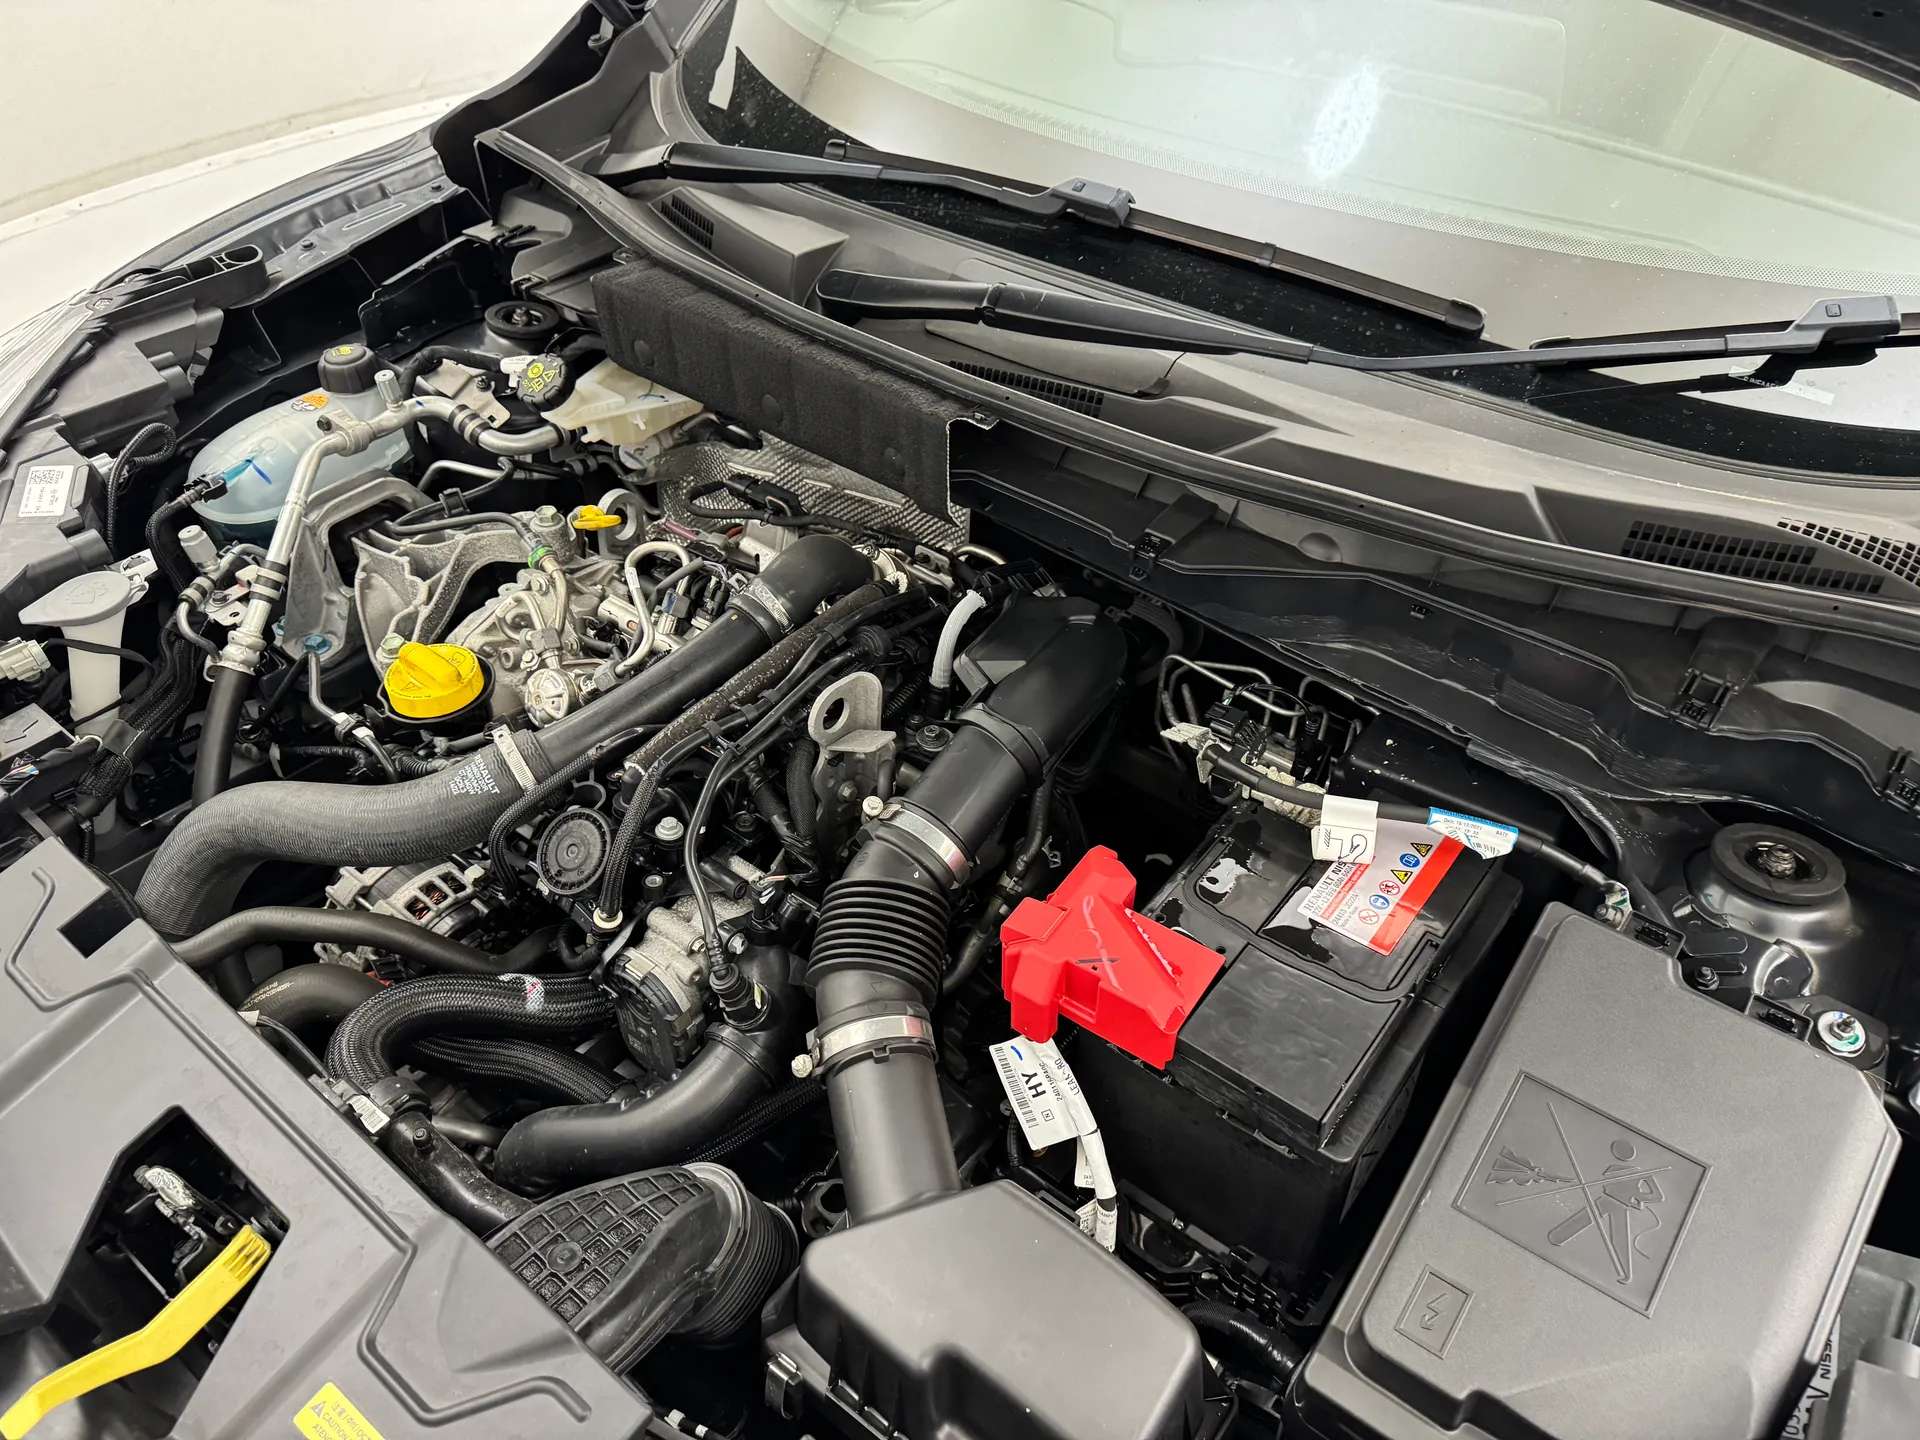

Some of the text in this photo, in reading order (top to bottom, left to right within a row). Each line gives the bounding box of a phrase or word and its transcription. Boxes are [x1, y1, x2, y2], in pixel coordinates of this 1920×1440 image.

[475, 754, 500, 794] RENAULT
[1303, 874, 1336, 911] RENAULT
[1331, 860, 1347, 875] NIS
[1021, 1072, 1047, 1098] HY
